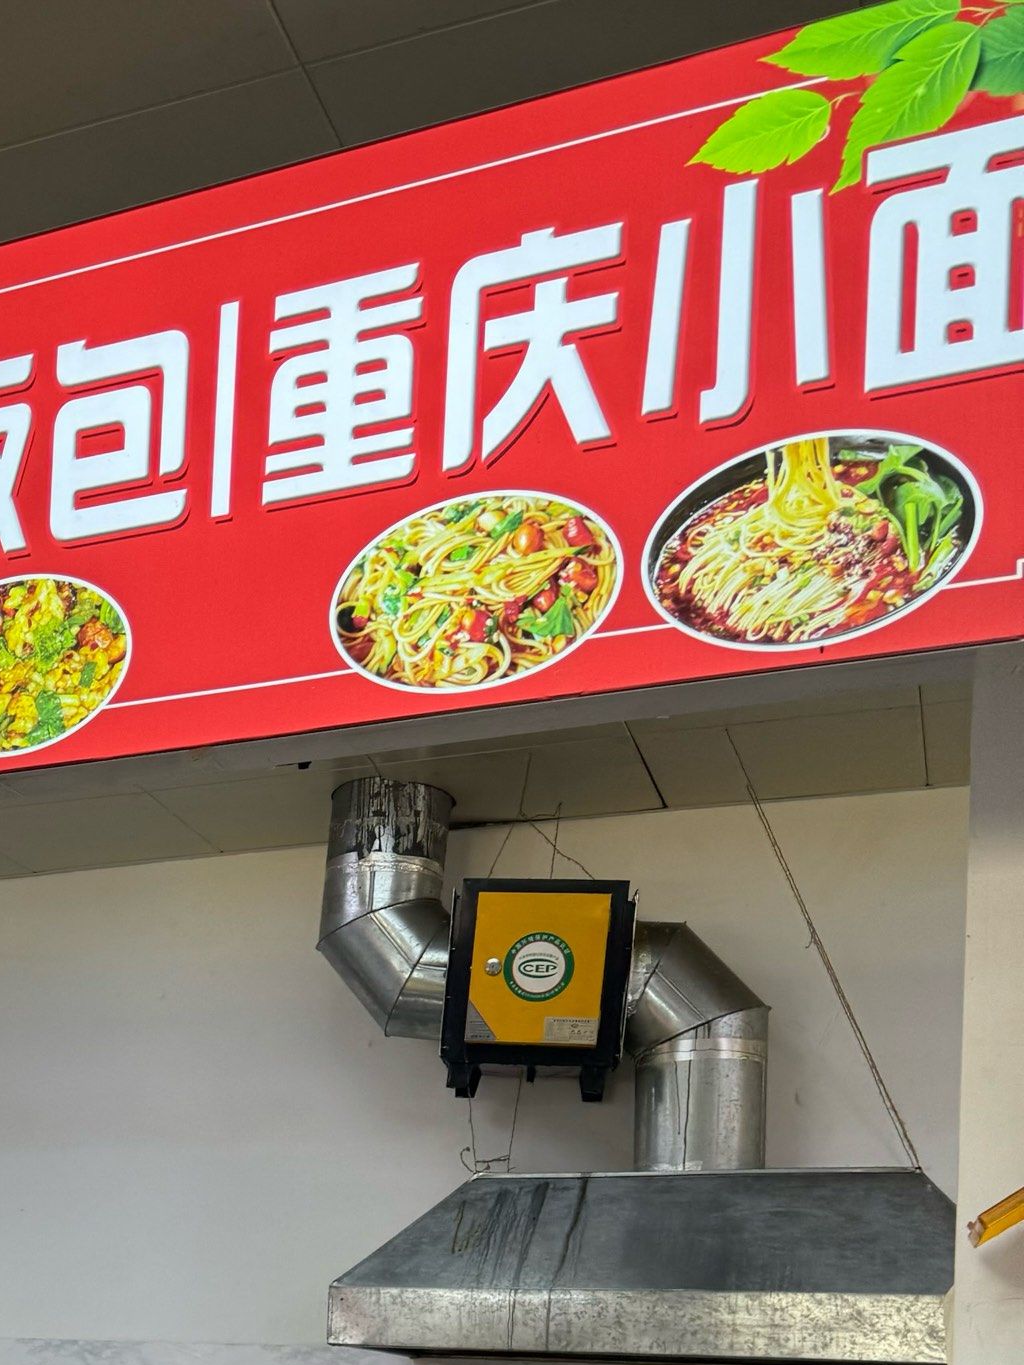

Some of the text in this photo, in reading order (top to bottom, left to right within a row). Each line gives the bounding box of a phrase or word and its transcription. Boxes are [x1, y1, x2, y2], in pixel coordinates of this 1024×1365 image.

[262, 116, 1024, 508] 重庆小面
[522, 964, 558, 973] CEP
